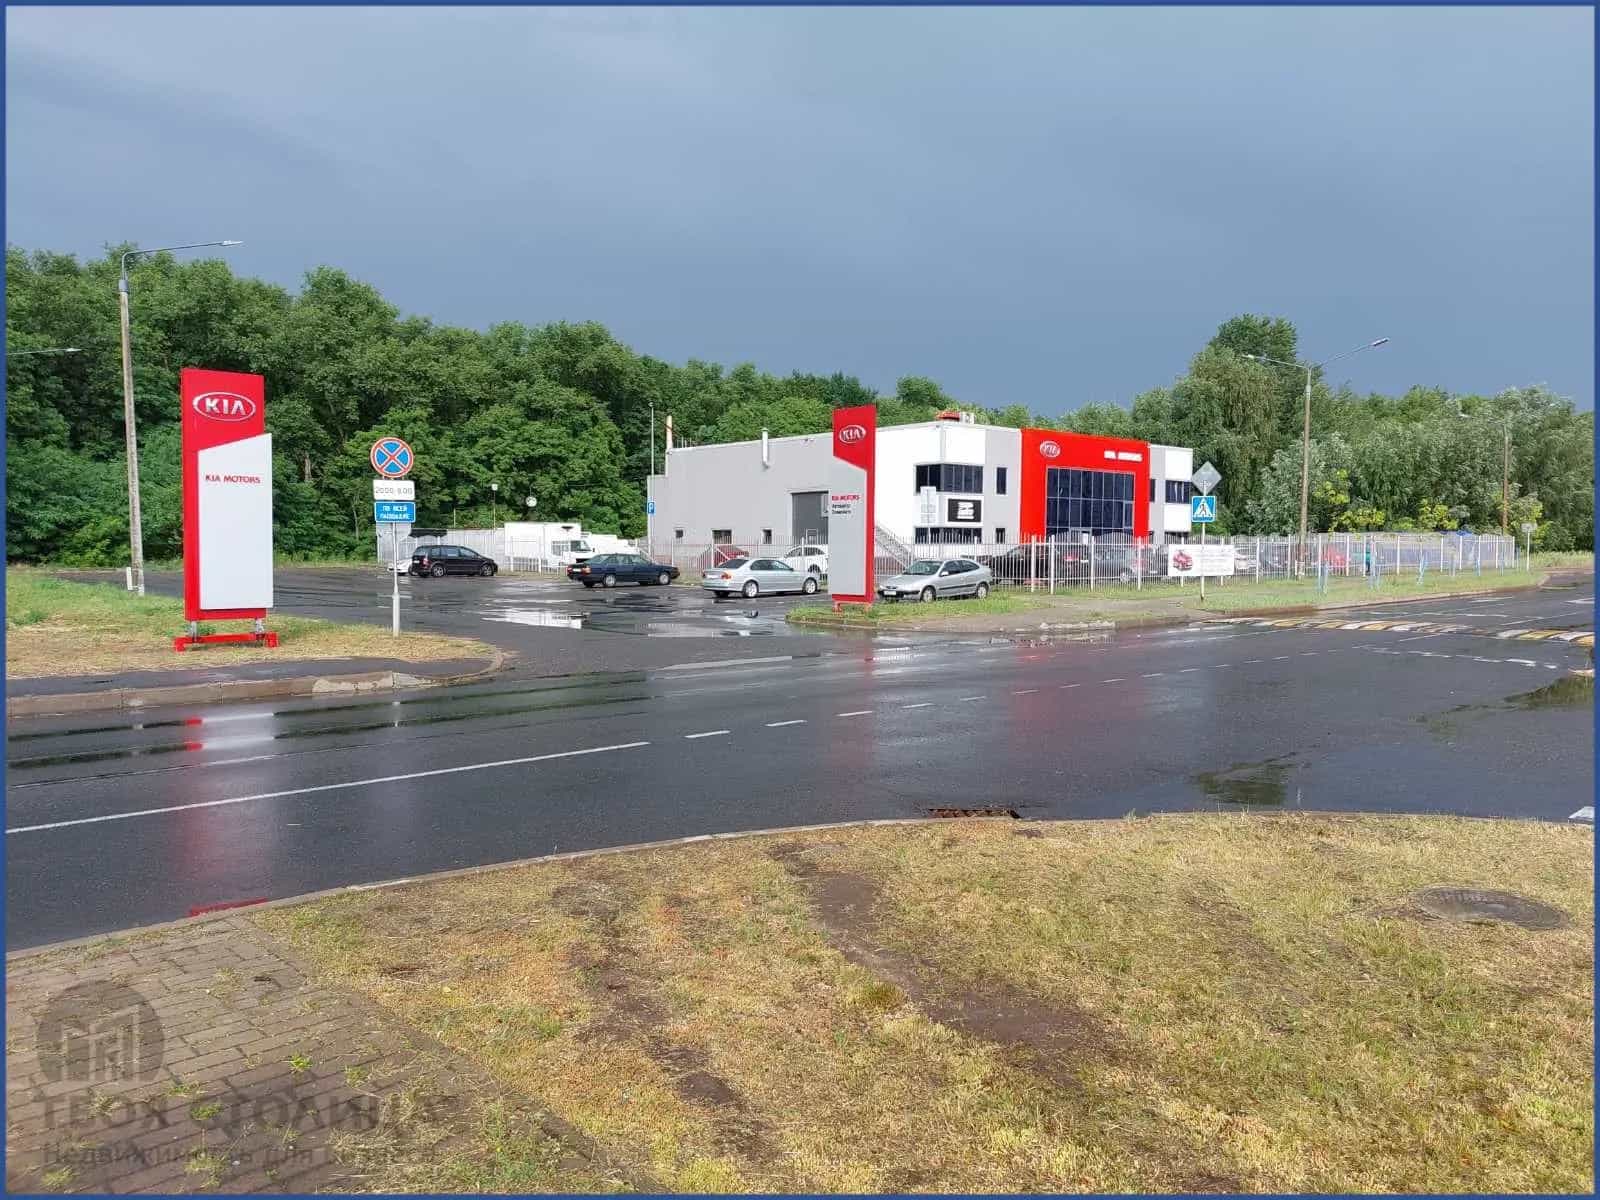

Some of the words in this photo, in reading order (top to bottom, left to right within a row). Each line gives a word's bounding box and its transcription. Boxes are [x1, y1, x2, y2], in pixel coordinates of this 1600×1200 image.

[204, 397, 247, 416] KIA
[205, 474, 221, 482] KIA
[223, 475, 261, 484] MOTORS
